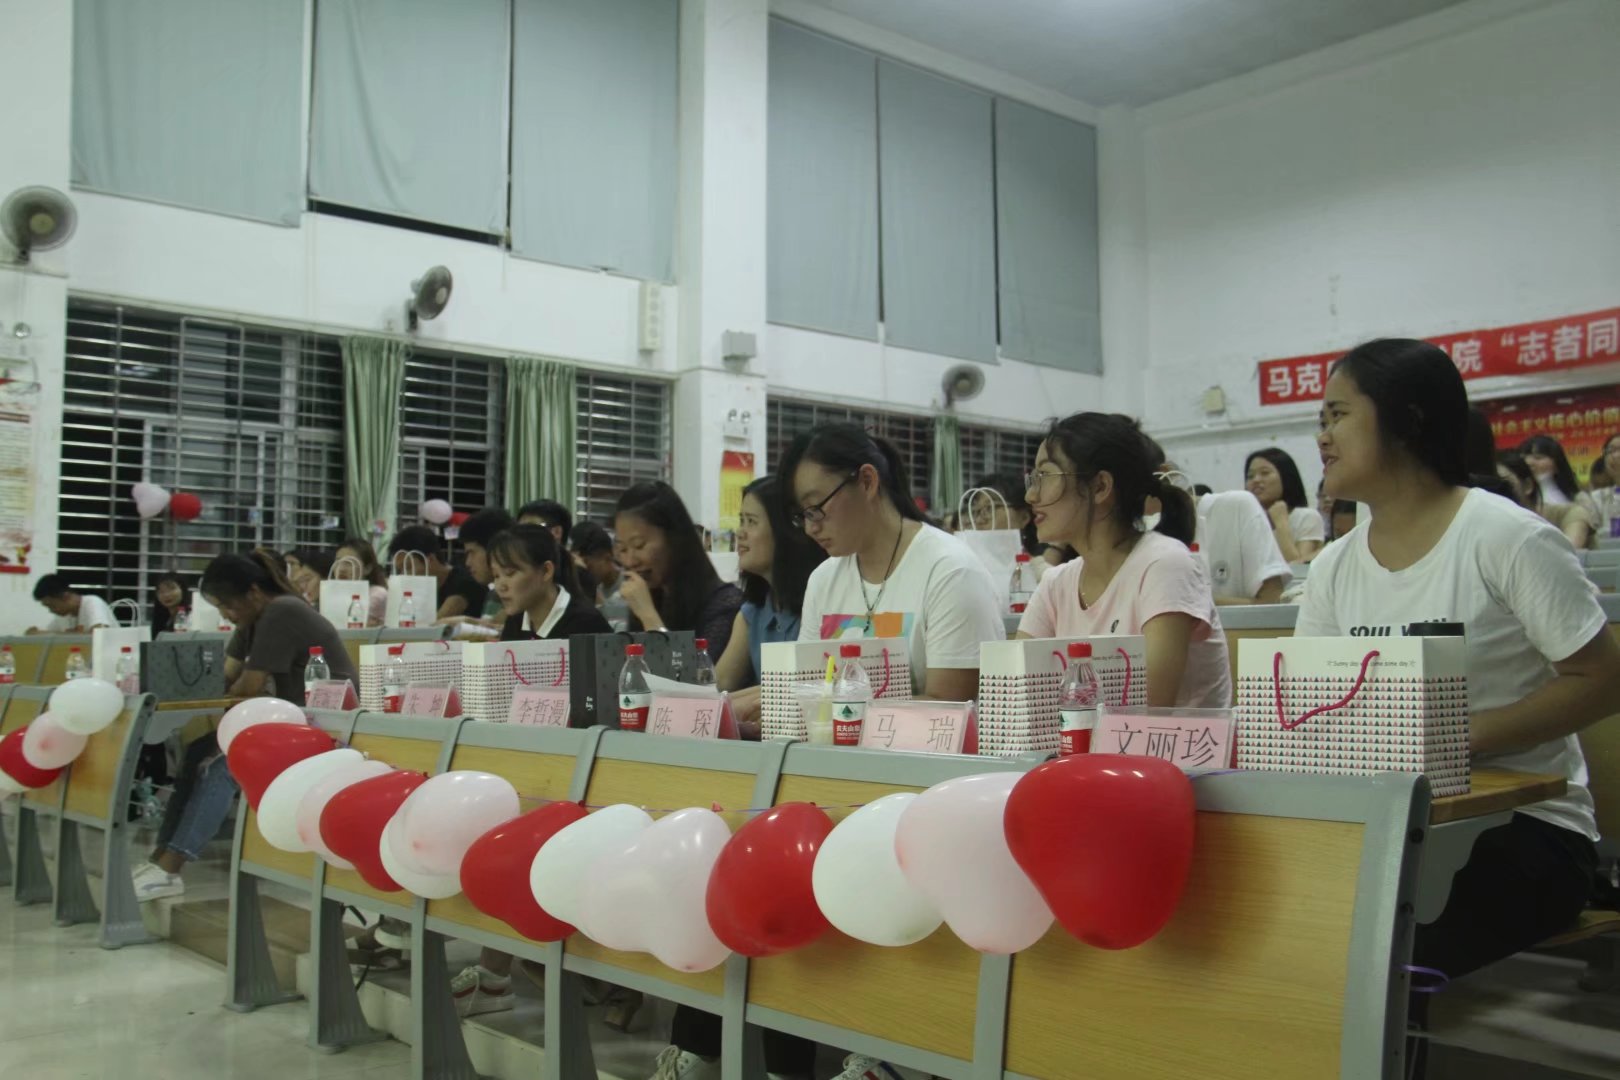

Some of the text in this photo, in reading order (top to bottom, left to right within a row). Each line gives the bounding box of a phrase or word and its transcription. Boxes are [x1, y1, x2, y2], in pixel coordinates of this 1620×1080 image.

[1267, 361, 1334, 398] 马克
[1438, 339, 1482, 373] 院
[871, 714, 955, 750] 马瑞
[1110, 722, 1219, 767] 文丽珍
